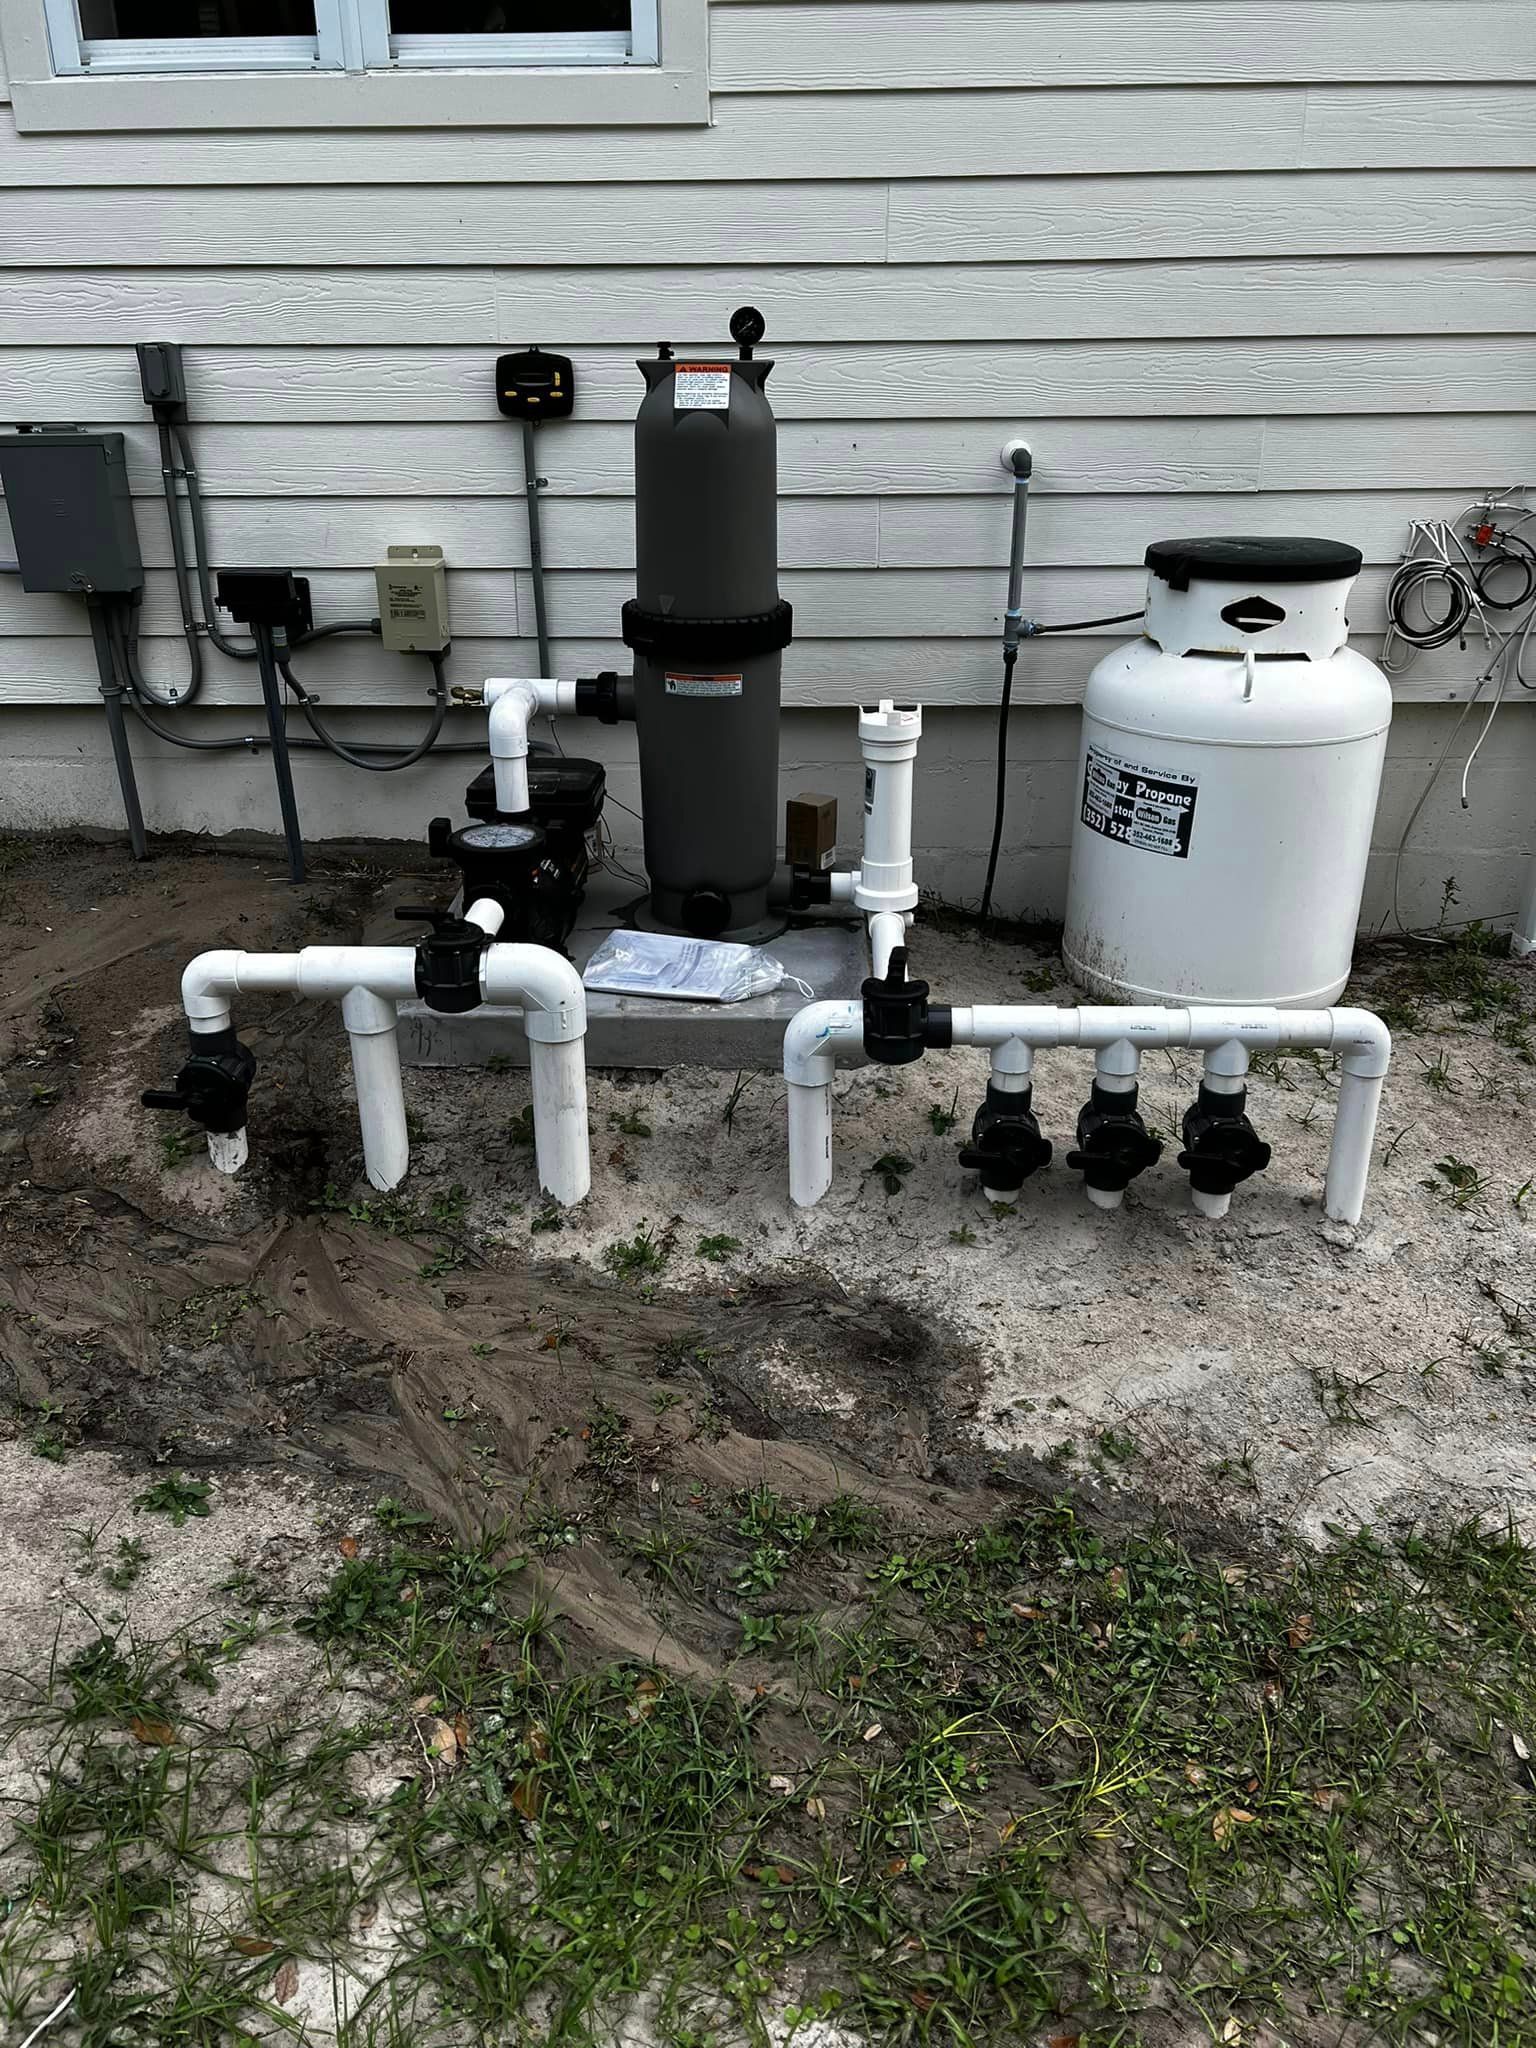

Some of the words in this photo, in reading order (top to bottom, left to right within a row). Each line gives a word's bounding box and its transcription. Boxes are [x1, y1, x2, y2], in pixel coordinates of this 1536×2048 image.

[1089, 745, 1112, 763] Property
[1123, 763, 1139, 772] and
[1141, 766, 1178, 780] Service
[1181, 774, 1196, 785] By
[1136, 780, 1192, 806] Propane
[1083, 803, 1106, 833] (352)
[1162, 815, 1176, 825] Gas
